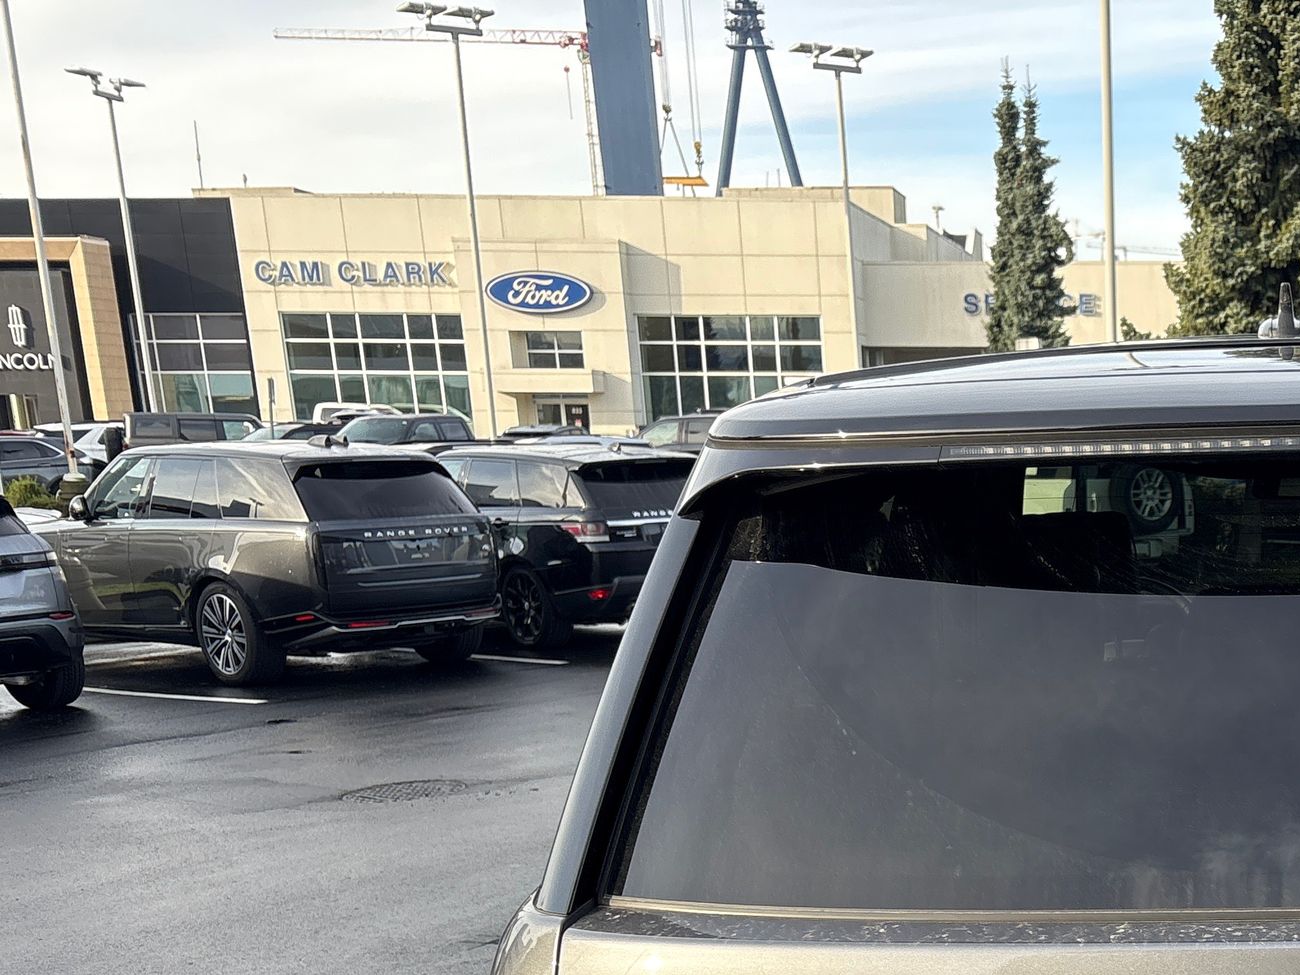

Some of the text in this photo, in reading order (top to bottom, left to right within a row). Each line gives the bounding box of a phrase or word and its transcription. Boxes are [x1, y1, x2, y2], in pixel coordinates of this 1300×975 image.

[254, 260, 447, 285] CAM CLARK
[507, 277, 570, 305] Ford
[363, 526, 468, 538] RANGE ROVER
